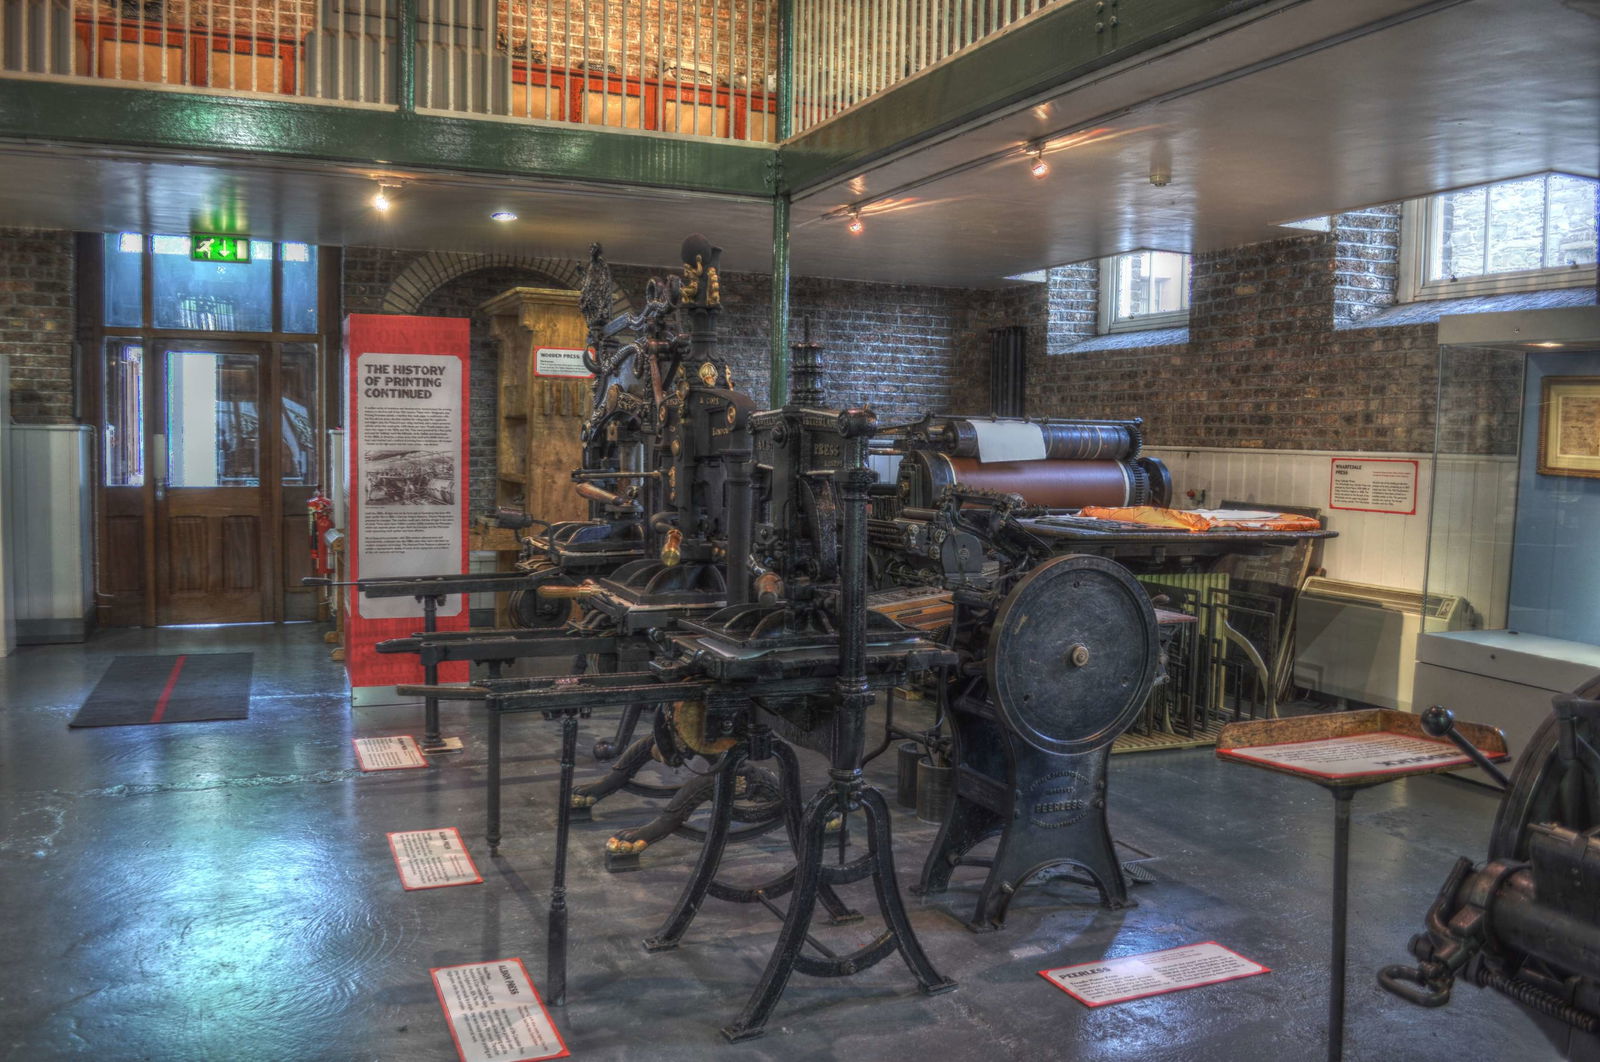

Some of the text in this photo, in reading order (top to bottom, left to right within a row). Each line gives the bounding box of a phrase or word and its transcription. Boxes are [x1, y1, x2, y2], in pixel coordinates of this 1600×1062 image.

[364, 364, 446, 376] THE HISTORY
[364, 376, 442, 388] OF PRINTING
[364, 388, 432, 399] CONTINUED
[814, 442, 839, 456] PRESS
[1034, 799, 1085, 814] PEERLESS
[1058, 966, 1111, 979] PEERLESS
[498, 965, 520, 995] ALBION PRESS
